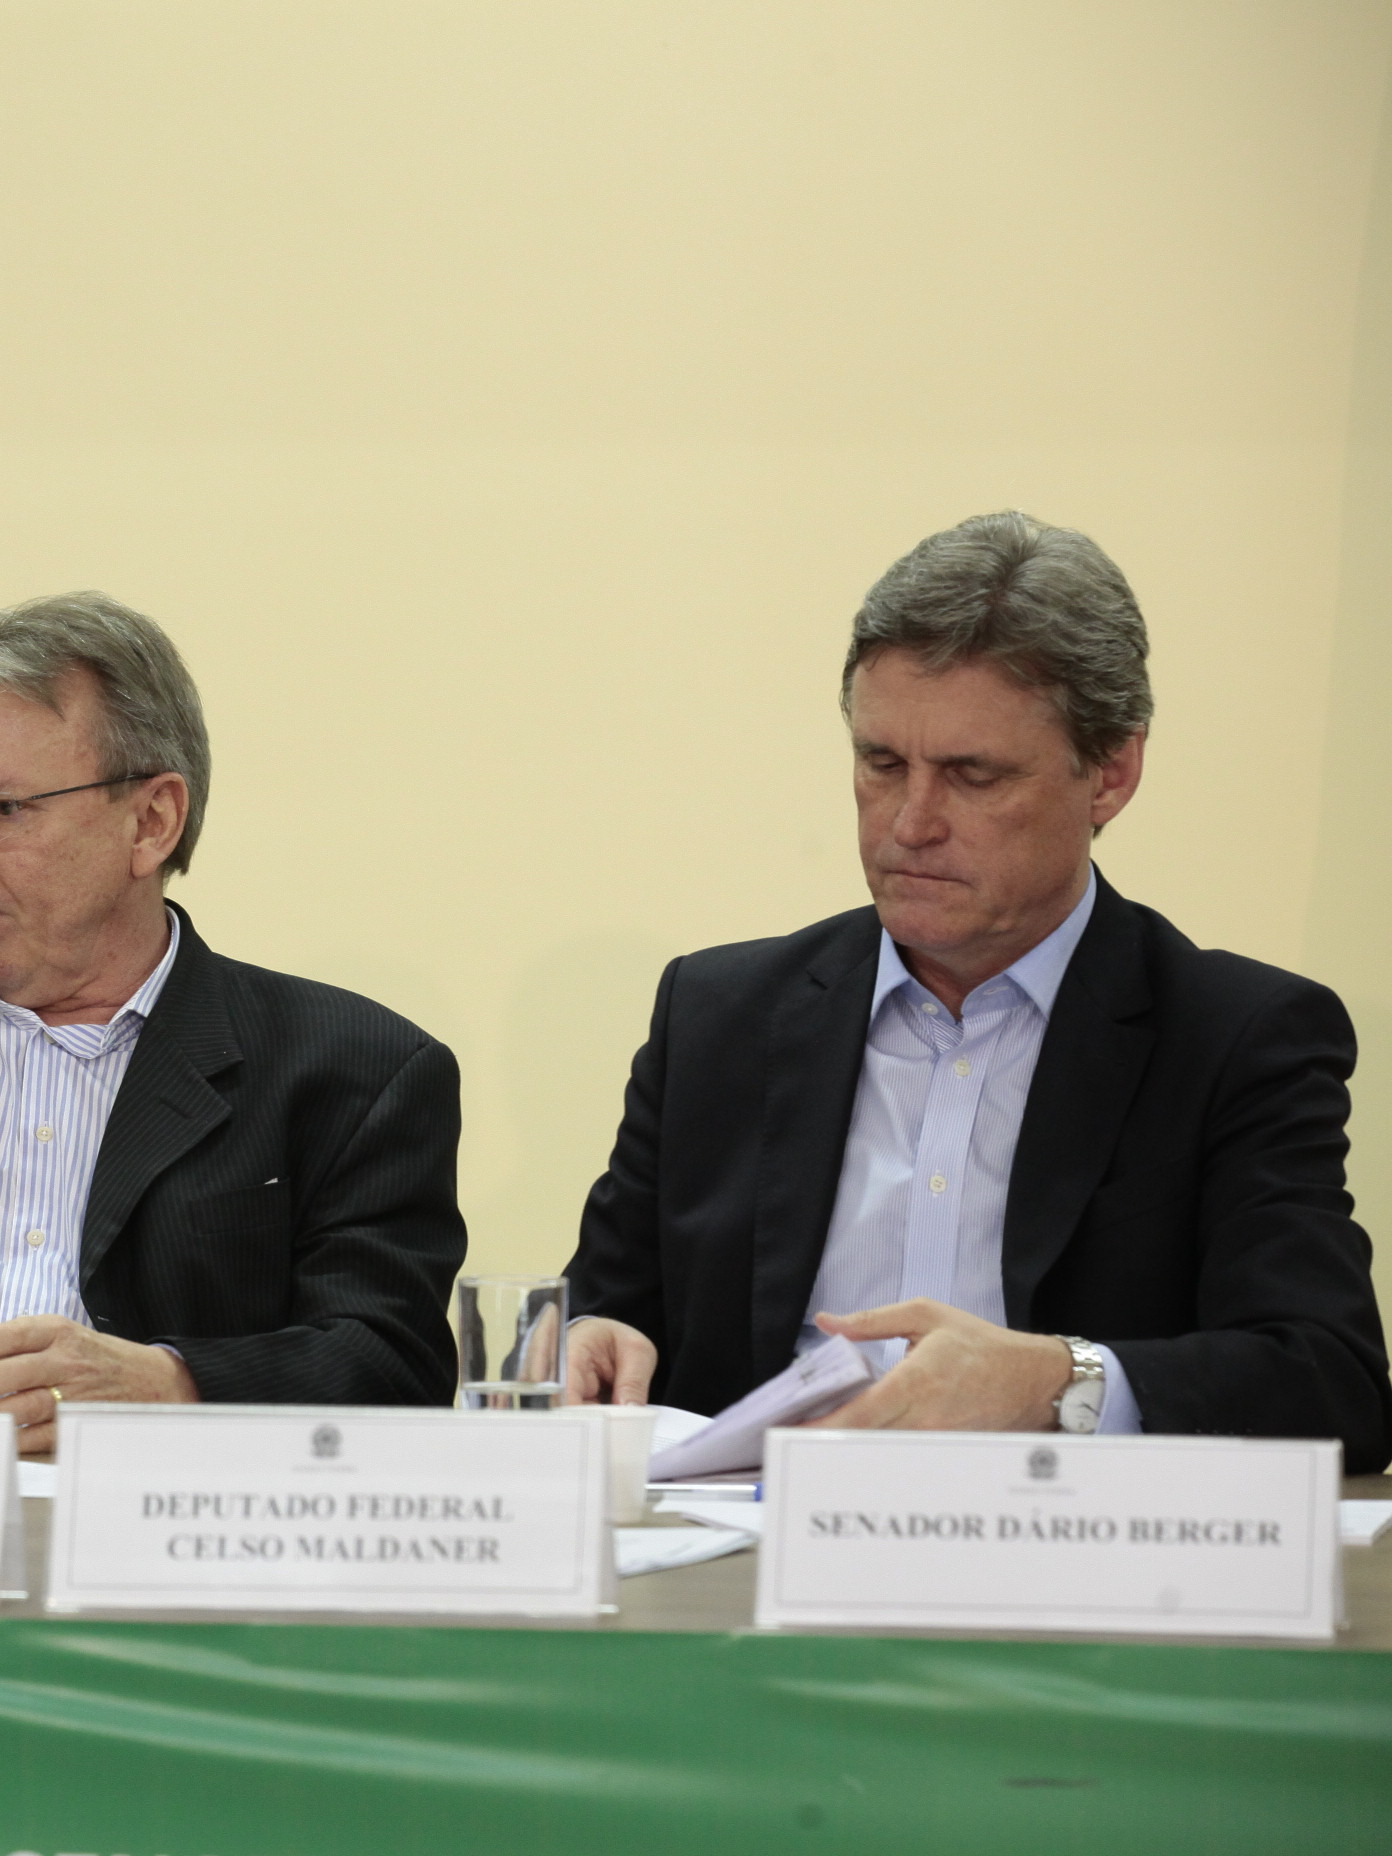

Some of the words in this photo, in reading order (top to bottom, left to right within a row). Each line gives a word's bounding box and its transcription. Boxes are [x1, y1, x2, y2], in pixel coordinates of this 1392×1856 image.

[142, 1491, 336, 1521] DEPUTADO
[346, 1493, 515, 1524] FEDERAL
[809, 1510, 986, 1541] SENADOR
[996, 1507, 1117, 1543] DÁRIO
[1128, 1516, 1283, 1547] BERGER
[166, 1533, 285, 1562] CELSO
[295, 1534, 501, 1564] MALDANER
